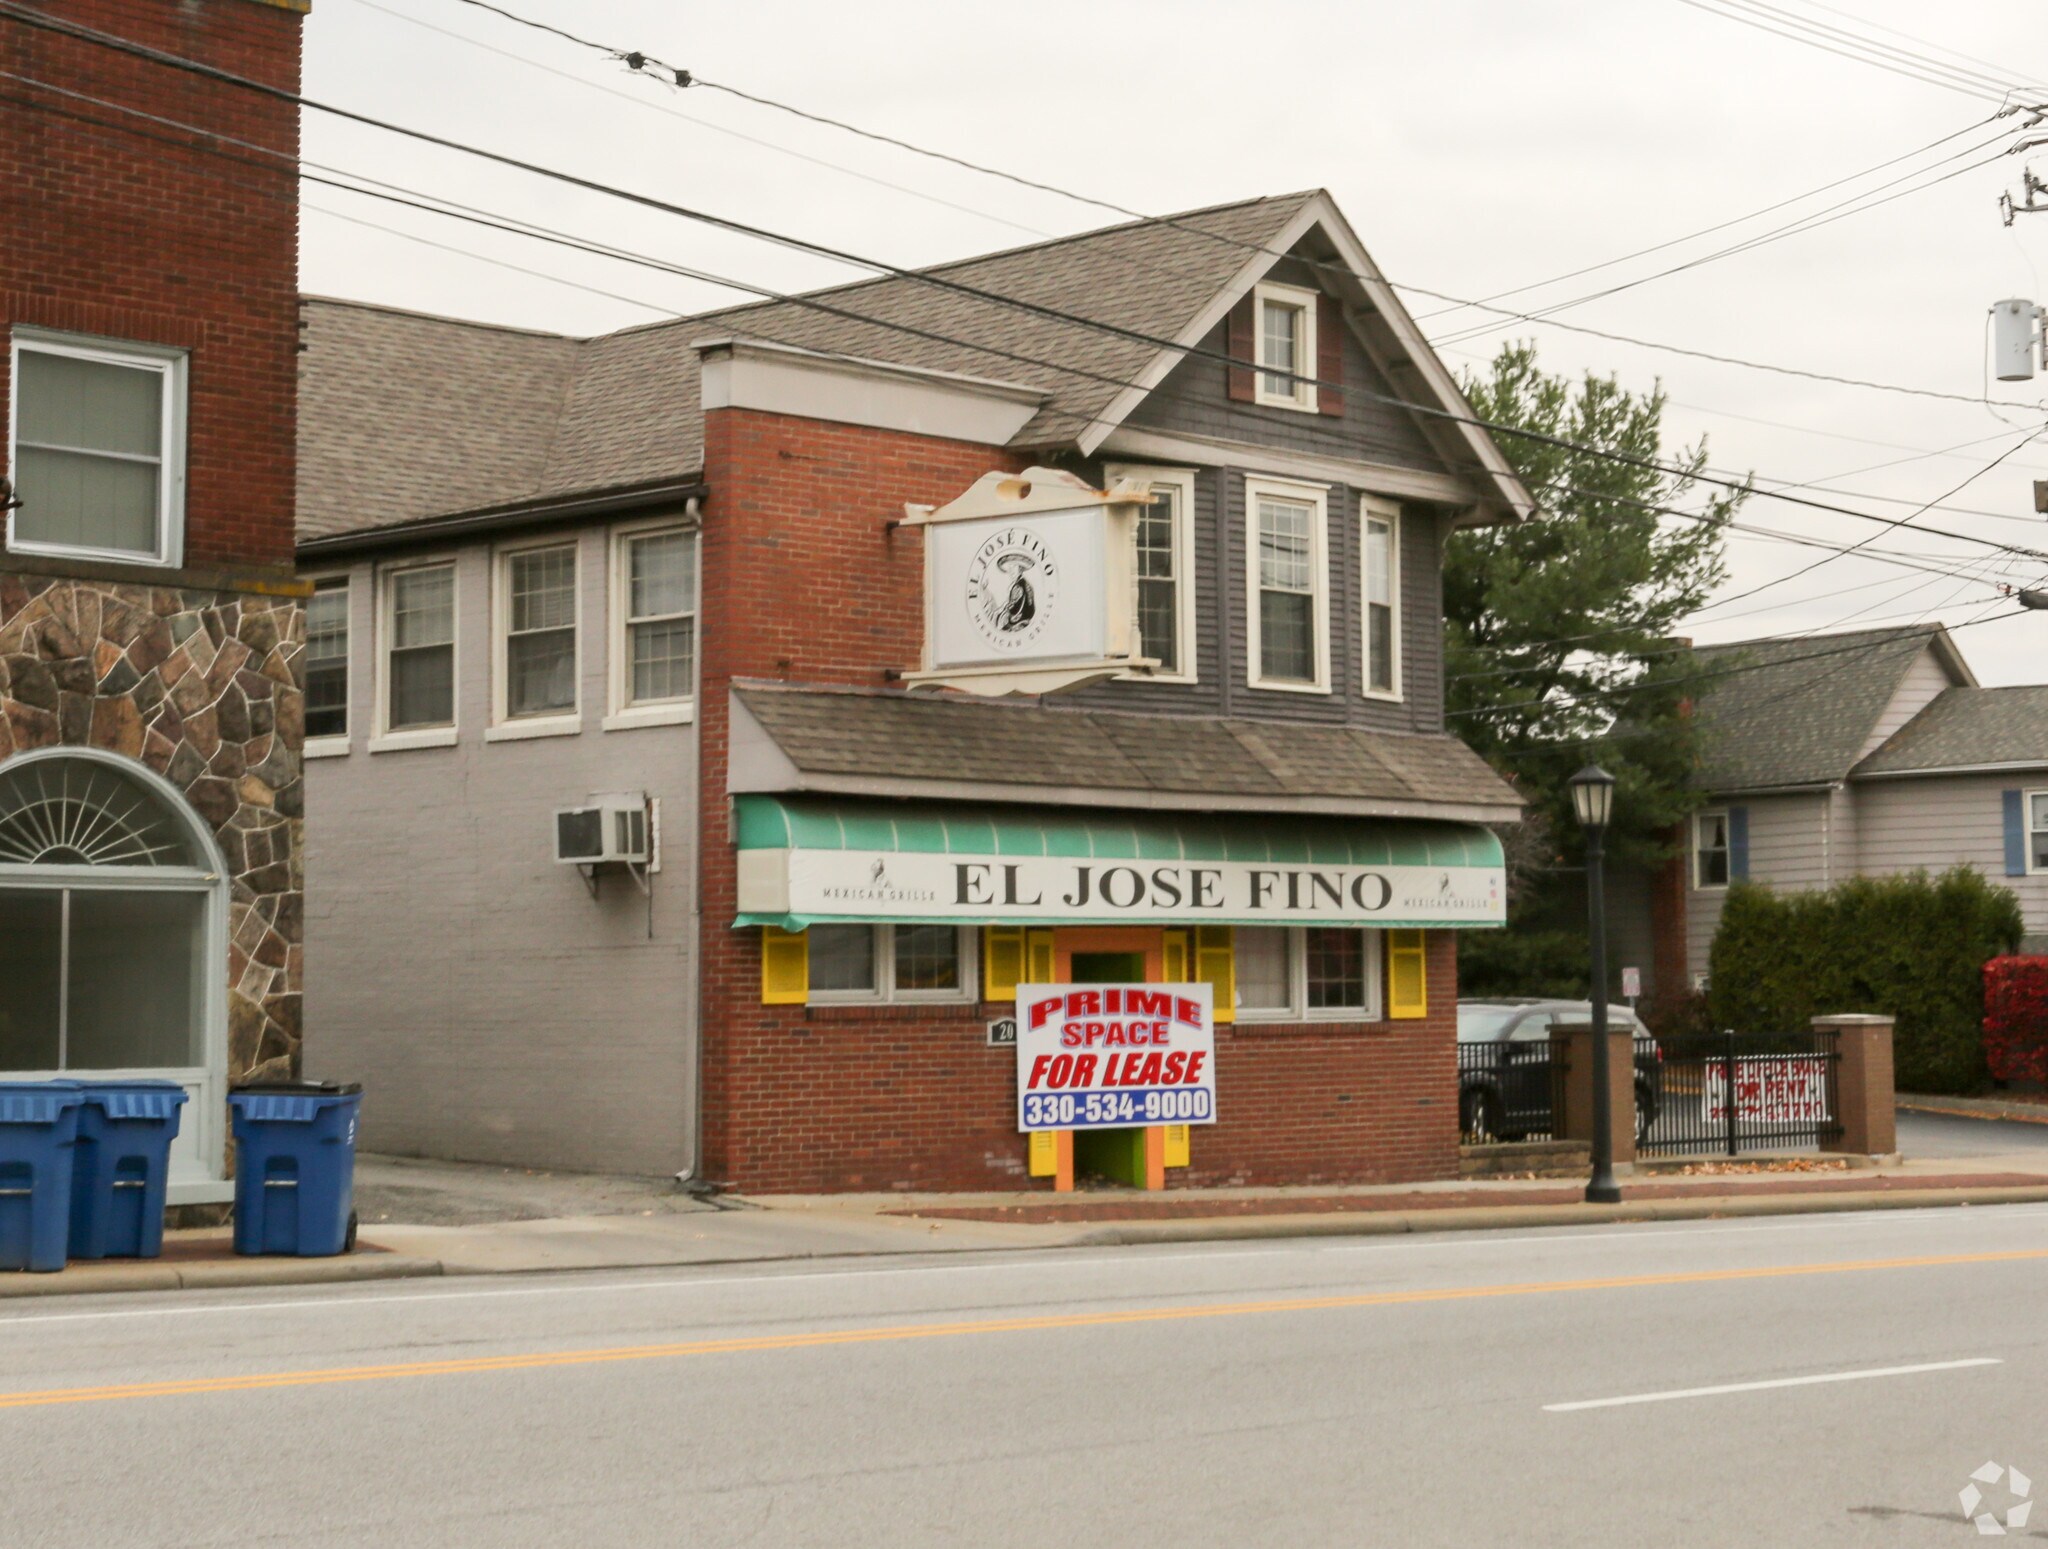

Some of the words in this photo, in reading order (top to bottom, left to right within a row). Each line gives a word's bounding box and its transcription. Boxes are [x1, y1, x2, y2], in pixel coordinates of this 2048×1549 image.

[968, 575, 980, 600] EL
[1021, 534, 1054, 576] FINO
[823, 888, 884, 900] MEXICAN
[889, 890, 935, 902] GRILLE
[950, 863, 1042, 906] EL
[1063, 866, 1225, 908] JOSE
[1246, 870, 1392, 911] FINO
[1404, 898, 1449, 908] MEXICAN
[1028, 988, 1203, 1032] PRIME
[1060, 1021, 1170, 1048] SPACE
[1027, 1054, 1099, 1089] FOR
[1101, 1051, 1207, 1087] LEASE
[1026, 1090, 1209, 1125] 330-534-9000
